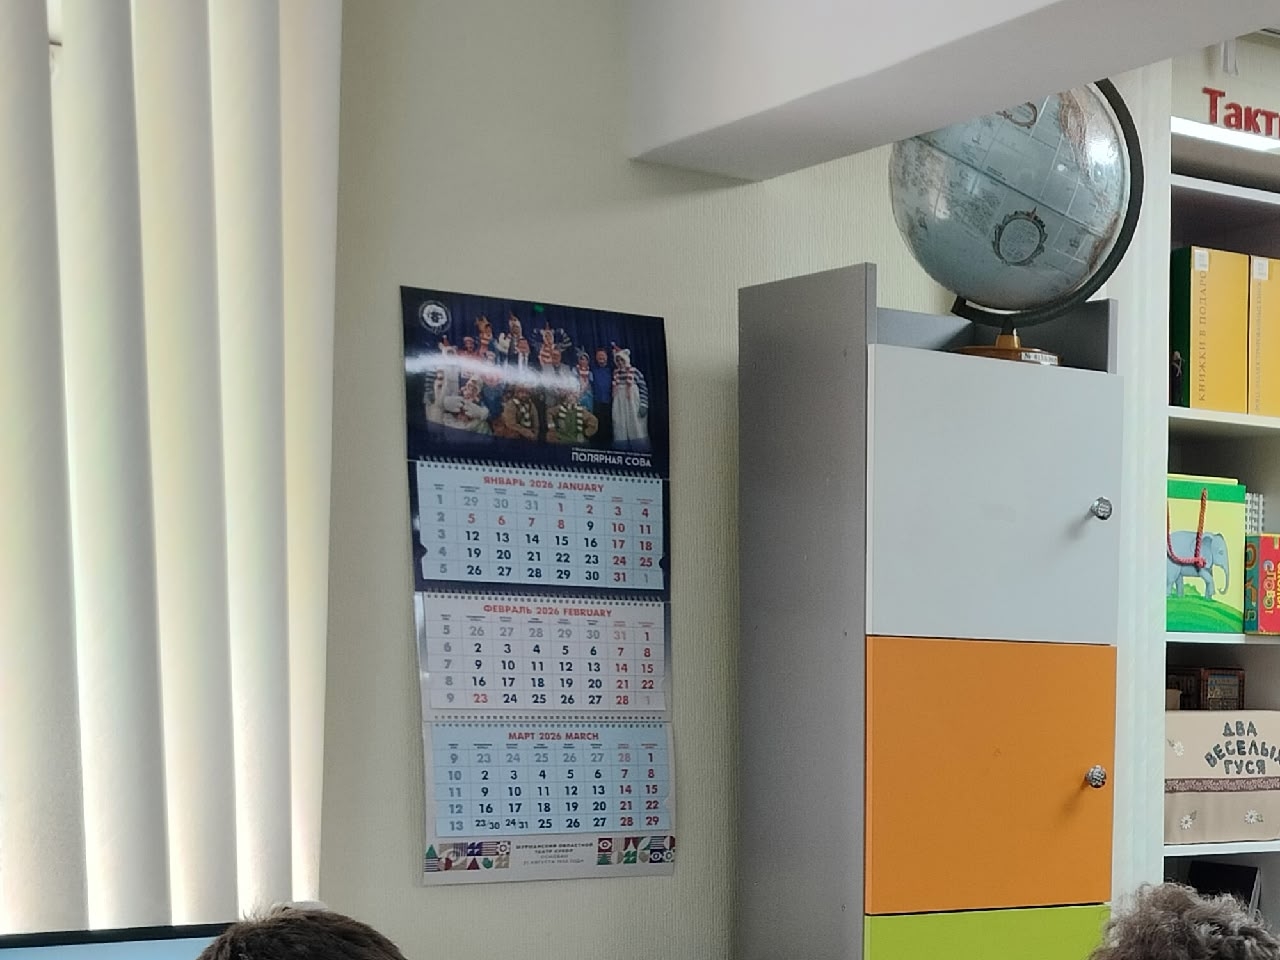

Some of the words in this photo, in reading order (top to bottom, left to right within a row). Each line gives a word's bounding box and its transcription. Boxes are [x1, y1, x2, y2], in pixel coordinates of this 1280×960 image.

[1199, 270, 1207, 325] ПОДАРО
[1198, 343, 1207, 401] КНИЖКИ
[572, 452, 623, 465] ПОЛЯРНАЯ
[625, 457, 652, 467] СОВА
[483, 476, 526, 487] ЯНВАРЬ
[529, 479, 553, 489] 2026
[557, 481, 605, 493] JANUARY
[463, 496, 479, 507] 29
[493, 498, 509, 509] 30
[525, 499, 539, 511] 31
[558, 502, 563, 513] 1
[586, 504, 593, 515] 2
[614, 506, 622, 516] 3
[641, 508, 649, 518] 4
[467, 513, 476, 524] 5
[498, 515, 506, 526] 6
[528, 517, 535, 527] 7
[557, 519, 565, 530] 8
[586, 520, 594, 531] 9
[612, 522, 626, 533] 10
[639, 524, 651, 535] 11
[465, 530, 480, 541] 12
[496, 532, 510, 543] 13
[525, 533, 539, 544] 14
[555, 535, 569, 546] 15
[584, 537, 598, 548] 16
[612, 539, 626, 549] 17
[639, 540, 653, 551] 18
[467, 547, 482, 558] 19
[496, 549, 511, 560] 20
[527, 551, 541, 562] 21
[555, 552, 570, 563] 22
[585, 554, 599, 565] 23
[613, 555, 627, 566] 24
[639, 556, 653, 568] 25
[466, 565, 482, 576] 26
[497, 566, 512, 576] 27
[527, 567, 542, 578] 28
[556, 569, 571, 580] 29
[585, 570, 600, 581] 30
[613, 572, 626, 582] 31
[483, 604, 532, 615] ФЕВРАЛЬ
[536, 606, 560, 616] 2026
[563, 607, 612, 618] FEBRUARY
[469, 625, 485, 637] 26
[499, 626, 514, 637] 27
[528, 627, 544, 638] 28
[557, 628, 573, 638] 29
[586, 629, 600, 640] 30
[613, 630, 627, 641] 31
[644, 631, 649, 641] 1
[474, 642, 482, 653] 2
[504, 643, 512, 654] 3
[533, 644, 541, 654] 4
[562, 645, 569, 655] 5
[590, 646, 597, 656] 6
[617, 647, 624, 656] 7
[643, 647, 651, 658] 8
[475, 659, 482, 670] 9
[501, 660, 515, 671] 10
[531, 661, 544, 671] 11
[559, 661, 573, 672] 12
[587, 662, 601, 672] 13
[615, 663, 628, 673] 14
[641, 663, 654, 674] 15
[472, 676, 486, 687] 16
[502, 677, 516, 687] 17
[531, 677, 545, 688] 18
[560, 678, 573, 688] 19
[588, 678, 602, 689] 20
[616, 679, 629, 689] 21
[641, 679, 654, 690] 22
[473, 693, 488, 704] 23
[503, 693, 517, 704] 24
[531, 693, 547, 704] 25
[560, 694, 575, 705] 26
[588, 695, 602, 705] 27
[616, 695, 629, 705] 28
[508, 732, 535, 741] МАРТ
[539, 732, 562, 741] 2026
[565, 731, 599, 741] MARCH
[1222, 720, 1258, 737] ДВА
[450, 753, 459, 764] 9
[476, 753, 492, 764] 23
[506, 753, 521, 763] 24
[534, 752, 549, 763] 25
[562, 752, 577, 763] 26
[590, 752, 605, 763] 27
[618, 752, 632, 763] 28
[648, 752, 653, 763] 1
[448, 770, 462, 781] 10
[481, 770, 489, 781] 2
[510, 770, 518, 780] 3
[538, 770, 546, 780] 4
[567, 769, 574, 779] 5
[594, 769, 602, 779] 6
[621, 768, 629, 779] 7
[647, 768, 655, 779] 8
[1223, 759, 1266, 775] ГУСЯ
[448, 787, 462, 797] 11
[481, 787, 489, 797] 9
[508, 786, 522, 797] 10
[537, 786, 550, 796] 11
[564, 785, 578, 796] 12
[592, 785, 605, 795] 13
[619, 784, 632, 795] 14
[645, 784, 658, 794] 15
[449, 803, 463, 814] 12
[479, 803, 493, 814] 16
[508, 802, 522, 813] 17
[537, 802, 551, 813] 18
[565, 801, 579, 812] 19
[592, 801, 607, 811] 20
[620, 800, 632, 811] 21
[645, 800, 659, 810] 22
[449, 820, 464, 831] 13
[538, 818, 553, 829] 25
[565, 818, 580, 828] 26
[593, 817, 607, 827] 27
[620, 816, 634, 827] 28
[645, 816, 660, 826] 29
